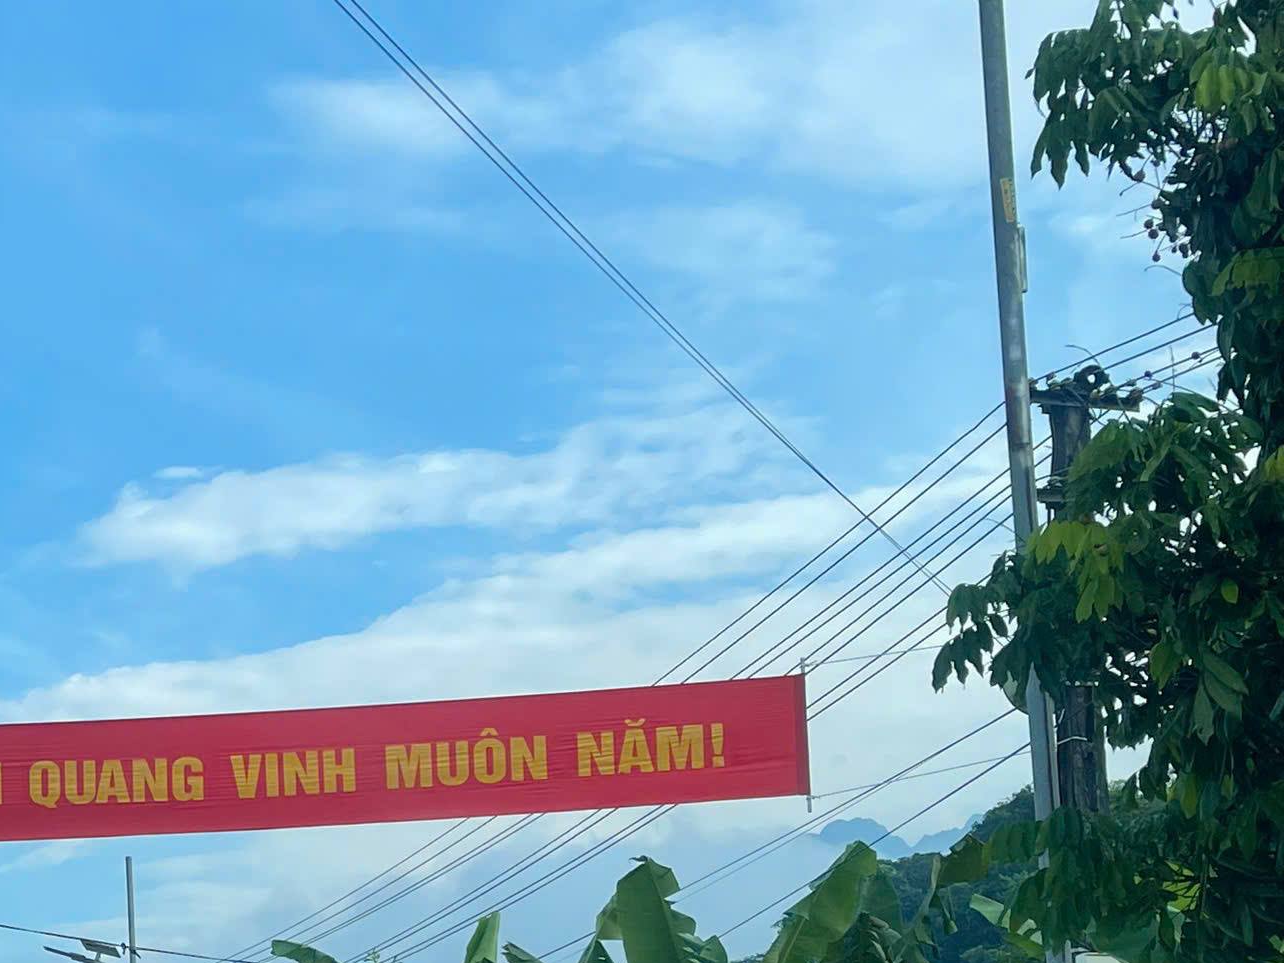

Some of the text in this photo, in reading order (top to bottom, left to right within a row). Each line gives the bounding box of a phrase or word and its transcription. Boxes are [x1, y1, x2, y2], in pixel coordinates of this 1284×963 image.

[28, 756, 204, 808] QUANG
[230, 747, 356, 800] VINH
[384, 727, 548, 790] MUÔN
[576, 719, 724, 777] NĂM!
